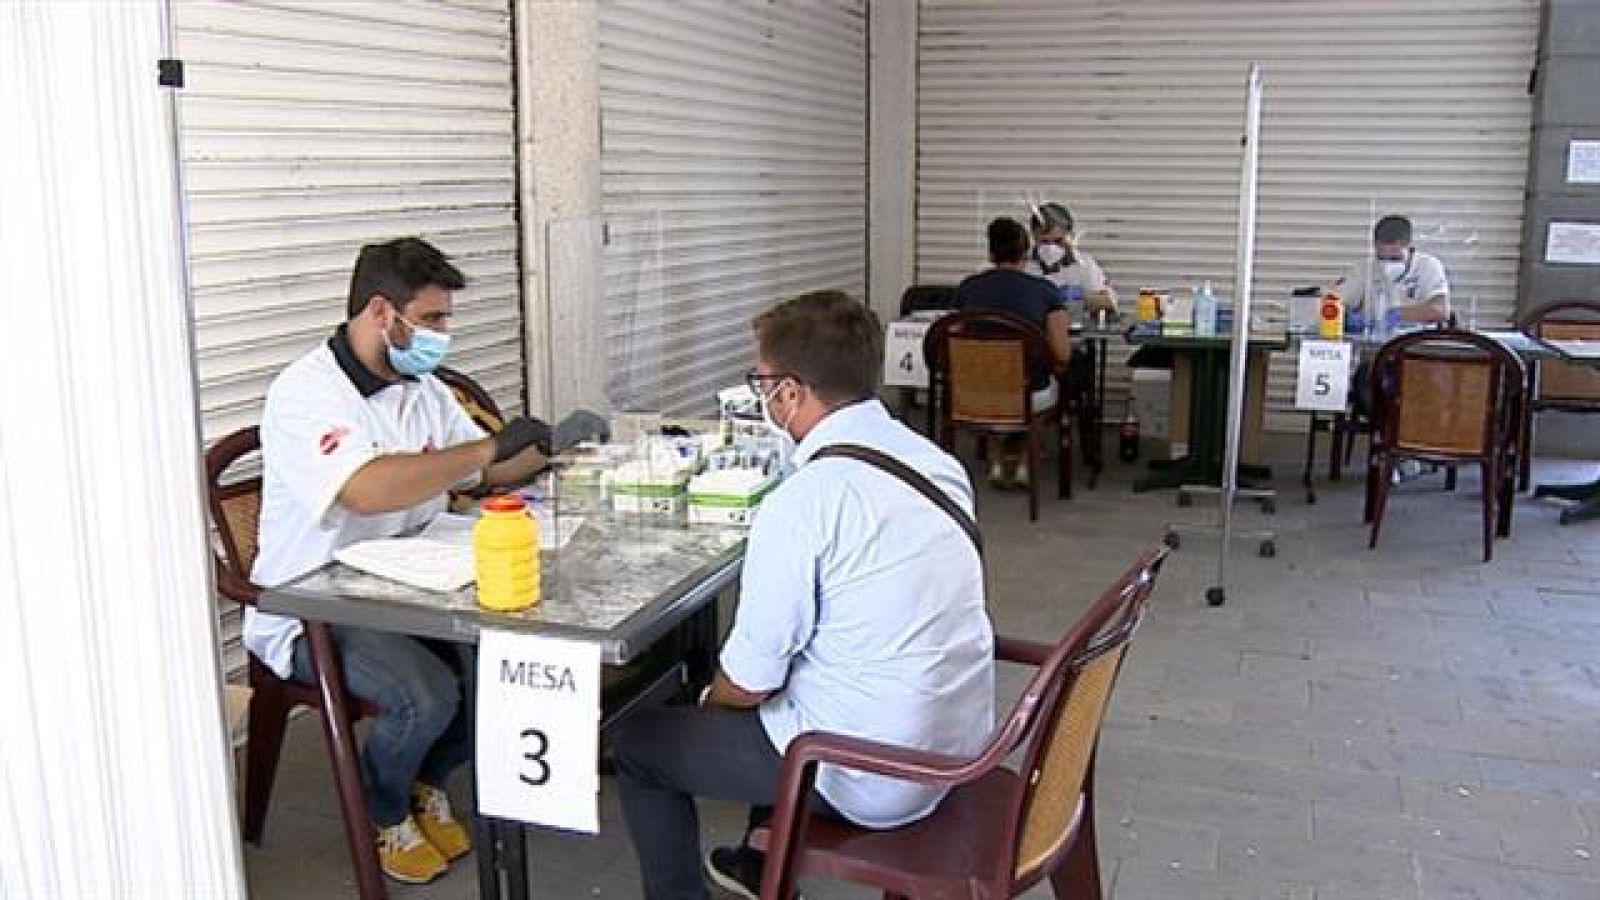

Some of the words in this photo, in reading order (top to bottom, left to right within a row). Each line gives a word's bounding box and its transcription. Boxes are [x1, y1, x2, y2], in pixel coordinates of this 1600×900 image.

[899, 351, 913, 373] 4
[1314, 372, 1331, 396] 5
[500, 659, 577, 694] MESA
[519, 727, 550, 786] 3
